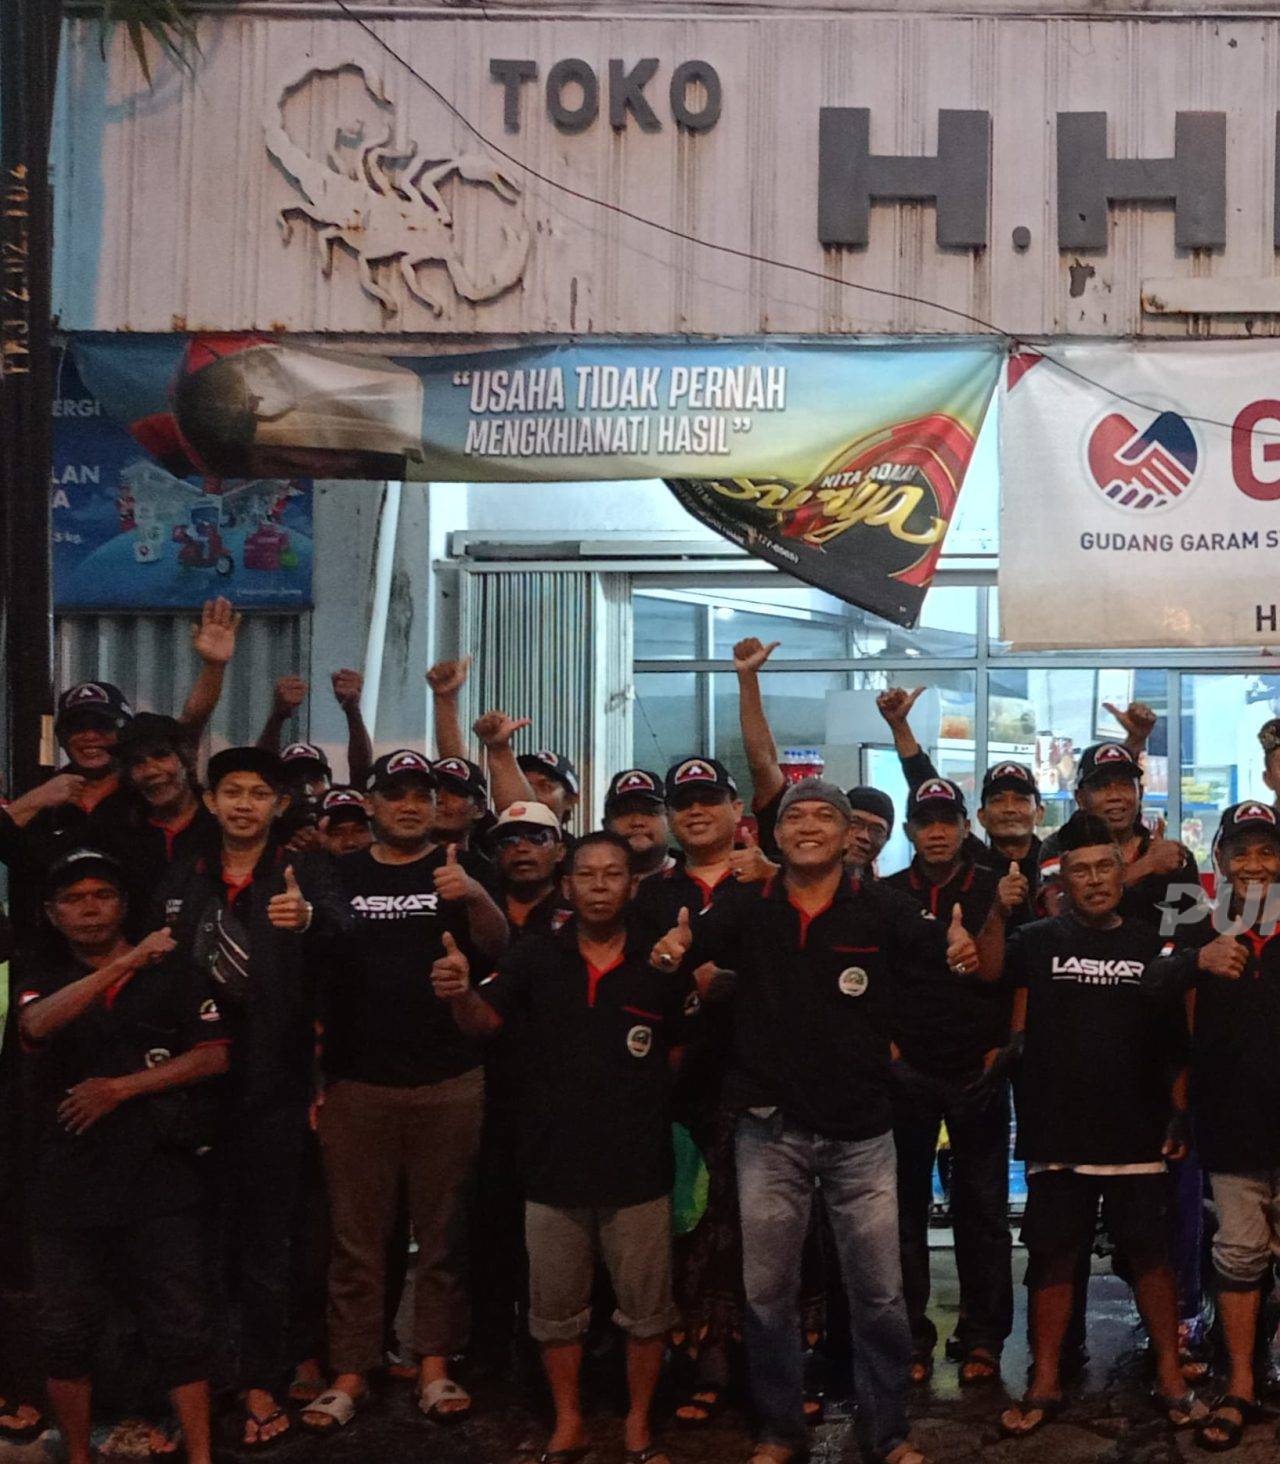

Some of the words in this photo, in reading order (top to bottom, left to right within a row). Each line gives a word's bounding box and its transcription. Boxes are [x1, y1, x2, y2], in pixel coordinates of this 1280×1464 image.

[490, 58, 725, 135] TOKO
[576, 366, 660, 411] TIDAK
[669, 366, 786, 411] PERNAH
[465, 417, 650, 457] MENGKHIANATI
[1080, 532, 1174, 553] GUDANG
[1180, 531, 1259, 552] GARAM
[1052, 956, 1145, 978] LASKAR
[1077, 975, 1120, 986] LANGIT
